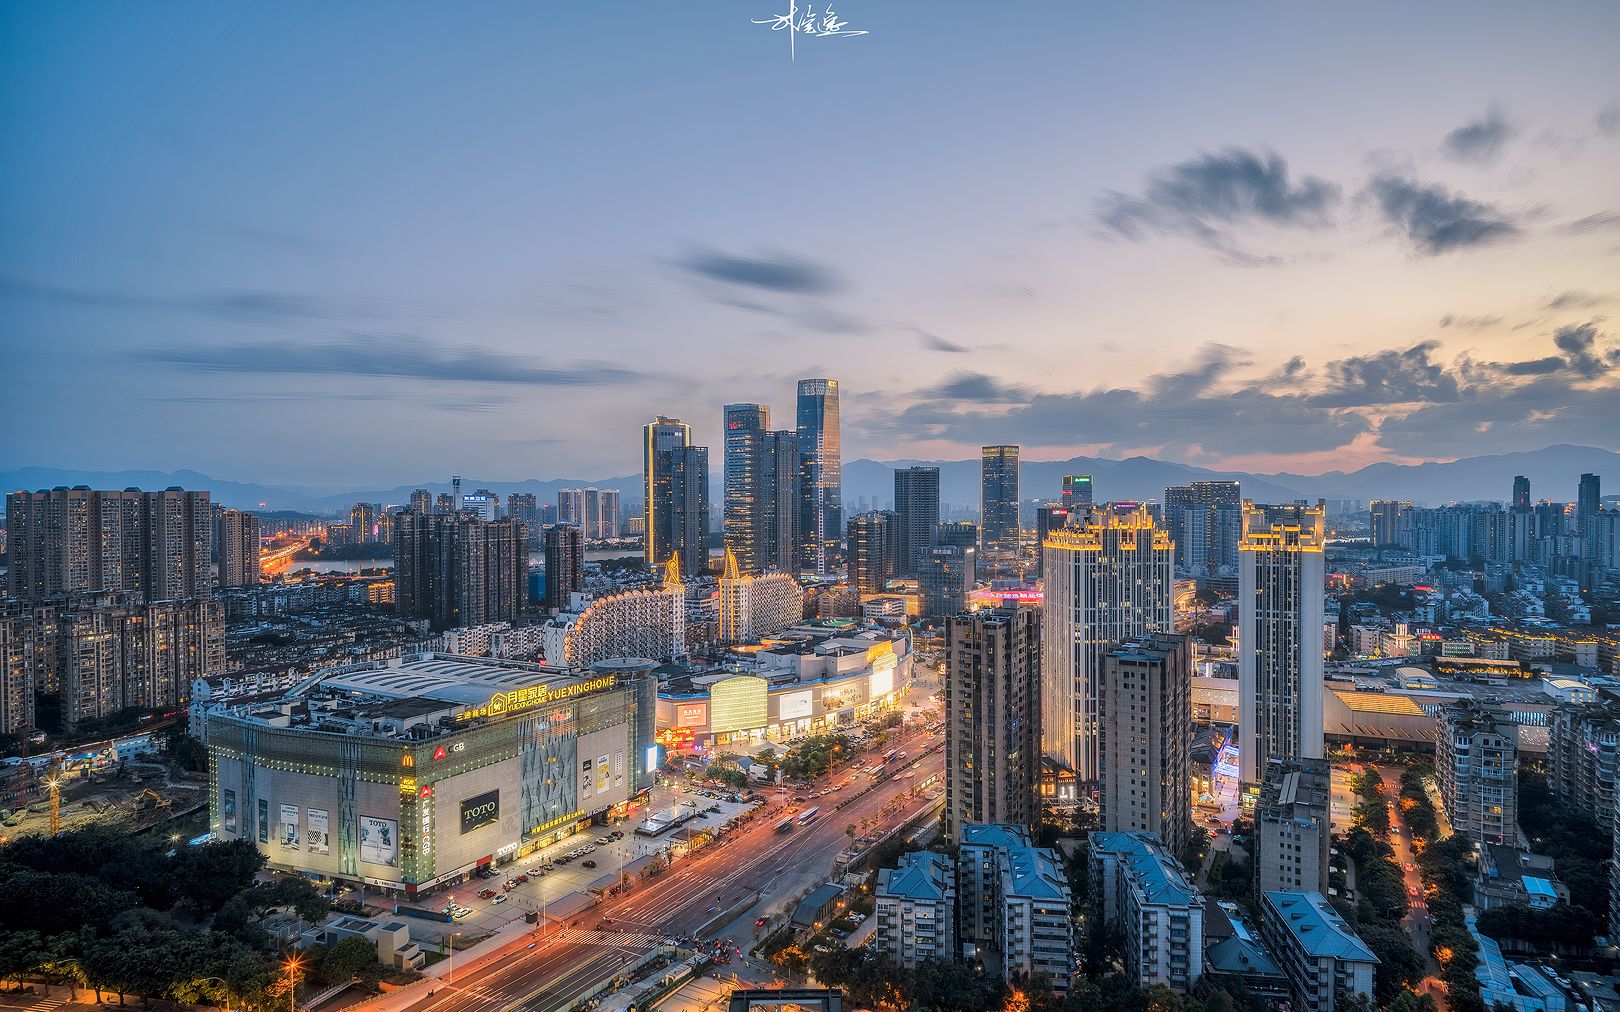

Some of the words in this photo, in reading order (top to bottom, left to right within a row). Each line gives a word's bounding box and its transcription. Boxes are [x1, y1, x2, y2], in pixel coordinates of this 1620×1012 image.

[507, 685, 549, 704] 月星家居
[547, 675, 615, 701] YUEXINGHOME
[448, 743, 465, 753] CGB
[464, 801, 496, 820] TOTO
[368, 819, 387, 828] TOTO
[497, 842, 518, 856] TOTO
